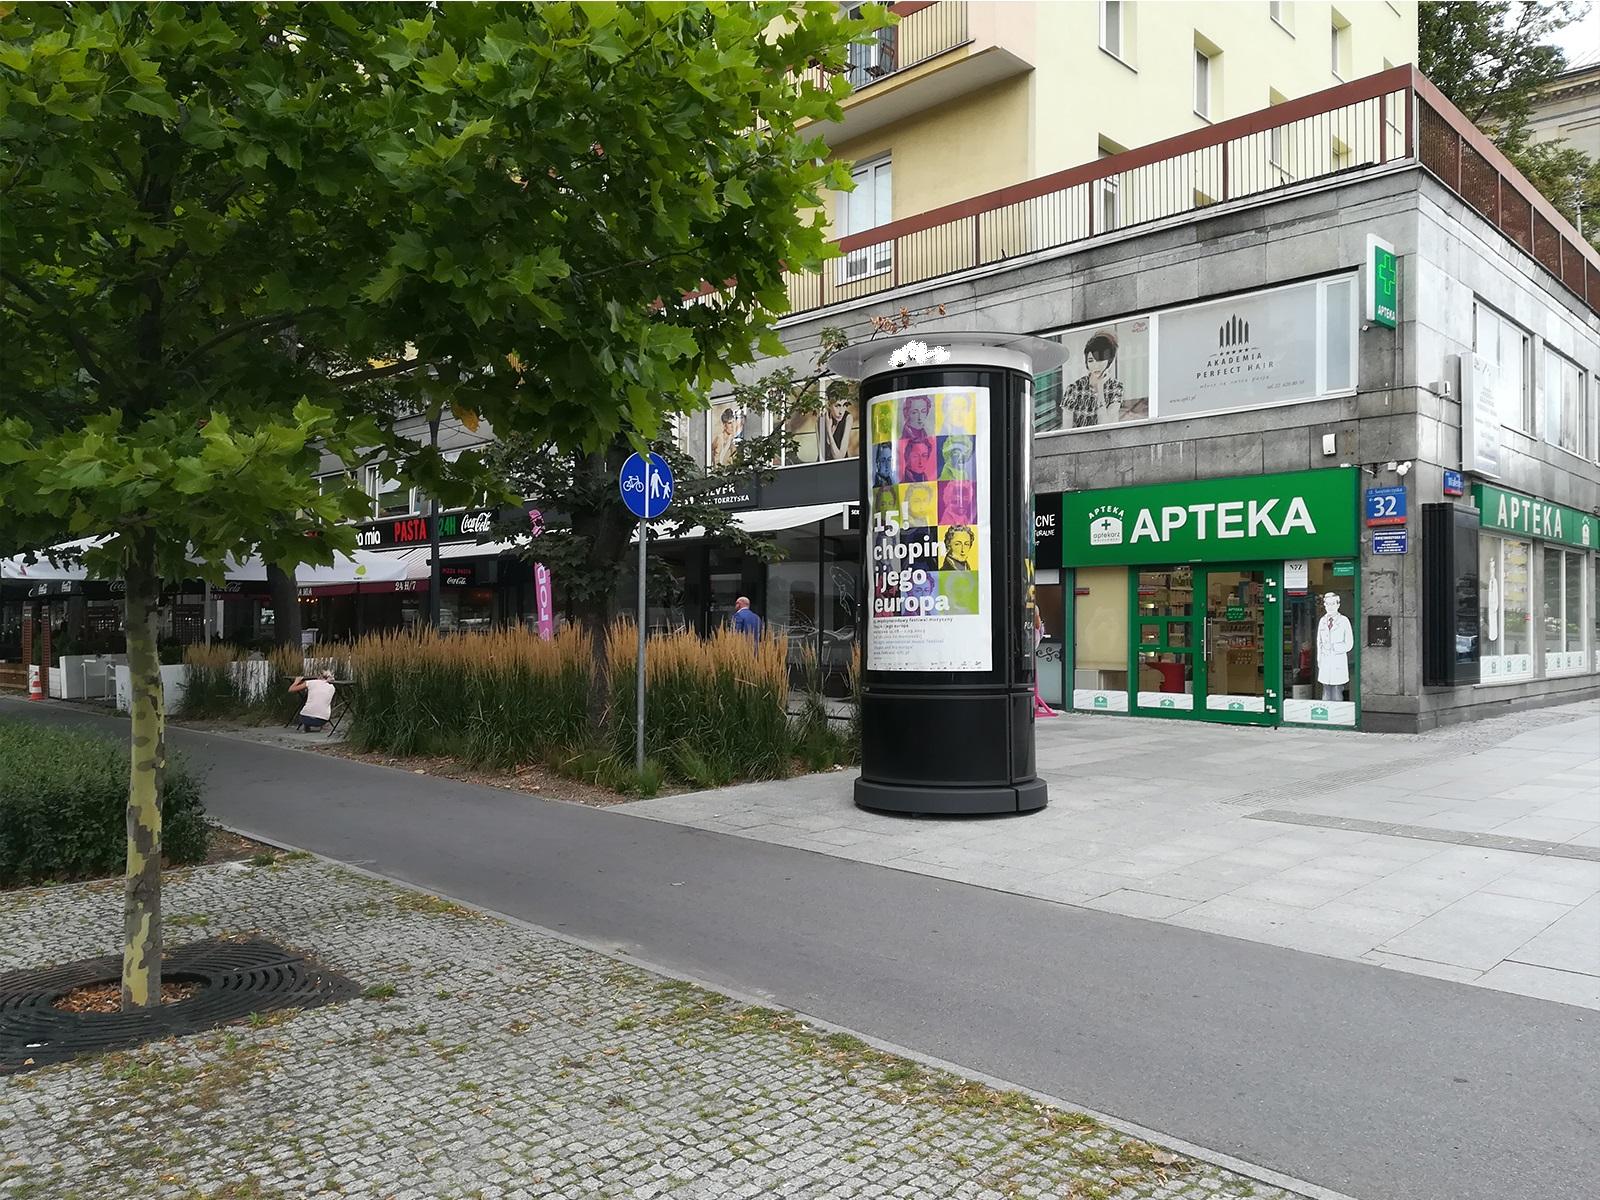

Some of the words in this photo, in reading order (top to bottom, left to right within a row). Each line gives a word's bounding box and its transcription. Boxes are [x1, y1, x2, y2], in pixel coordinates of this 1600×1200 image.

[1378, 304, 1396, 321] APTEKA
[1196, 366, 1242, 379] PERFECT
[1247, 361, 1275, 372] HAIR
[1206, 352, 1263, 368] AKADEMIA
[1088, 505, 1125, 520] APTEKA
[1373, 496, 1397, 517] 32
[1497, 493, 1563, 539] APTEKA
[394, 518, 427, 543] PASTA
[873, 501, 910, 537] 15!
[1130, 497, 1317, 544] APTEKA
[364, 526, 381, 545] mia
[873, 535, 948, 565] chopin
[880, 565, 927, 592] jego
[874, 594, 950, 618] europa
